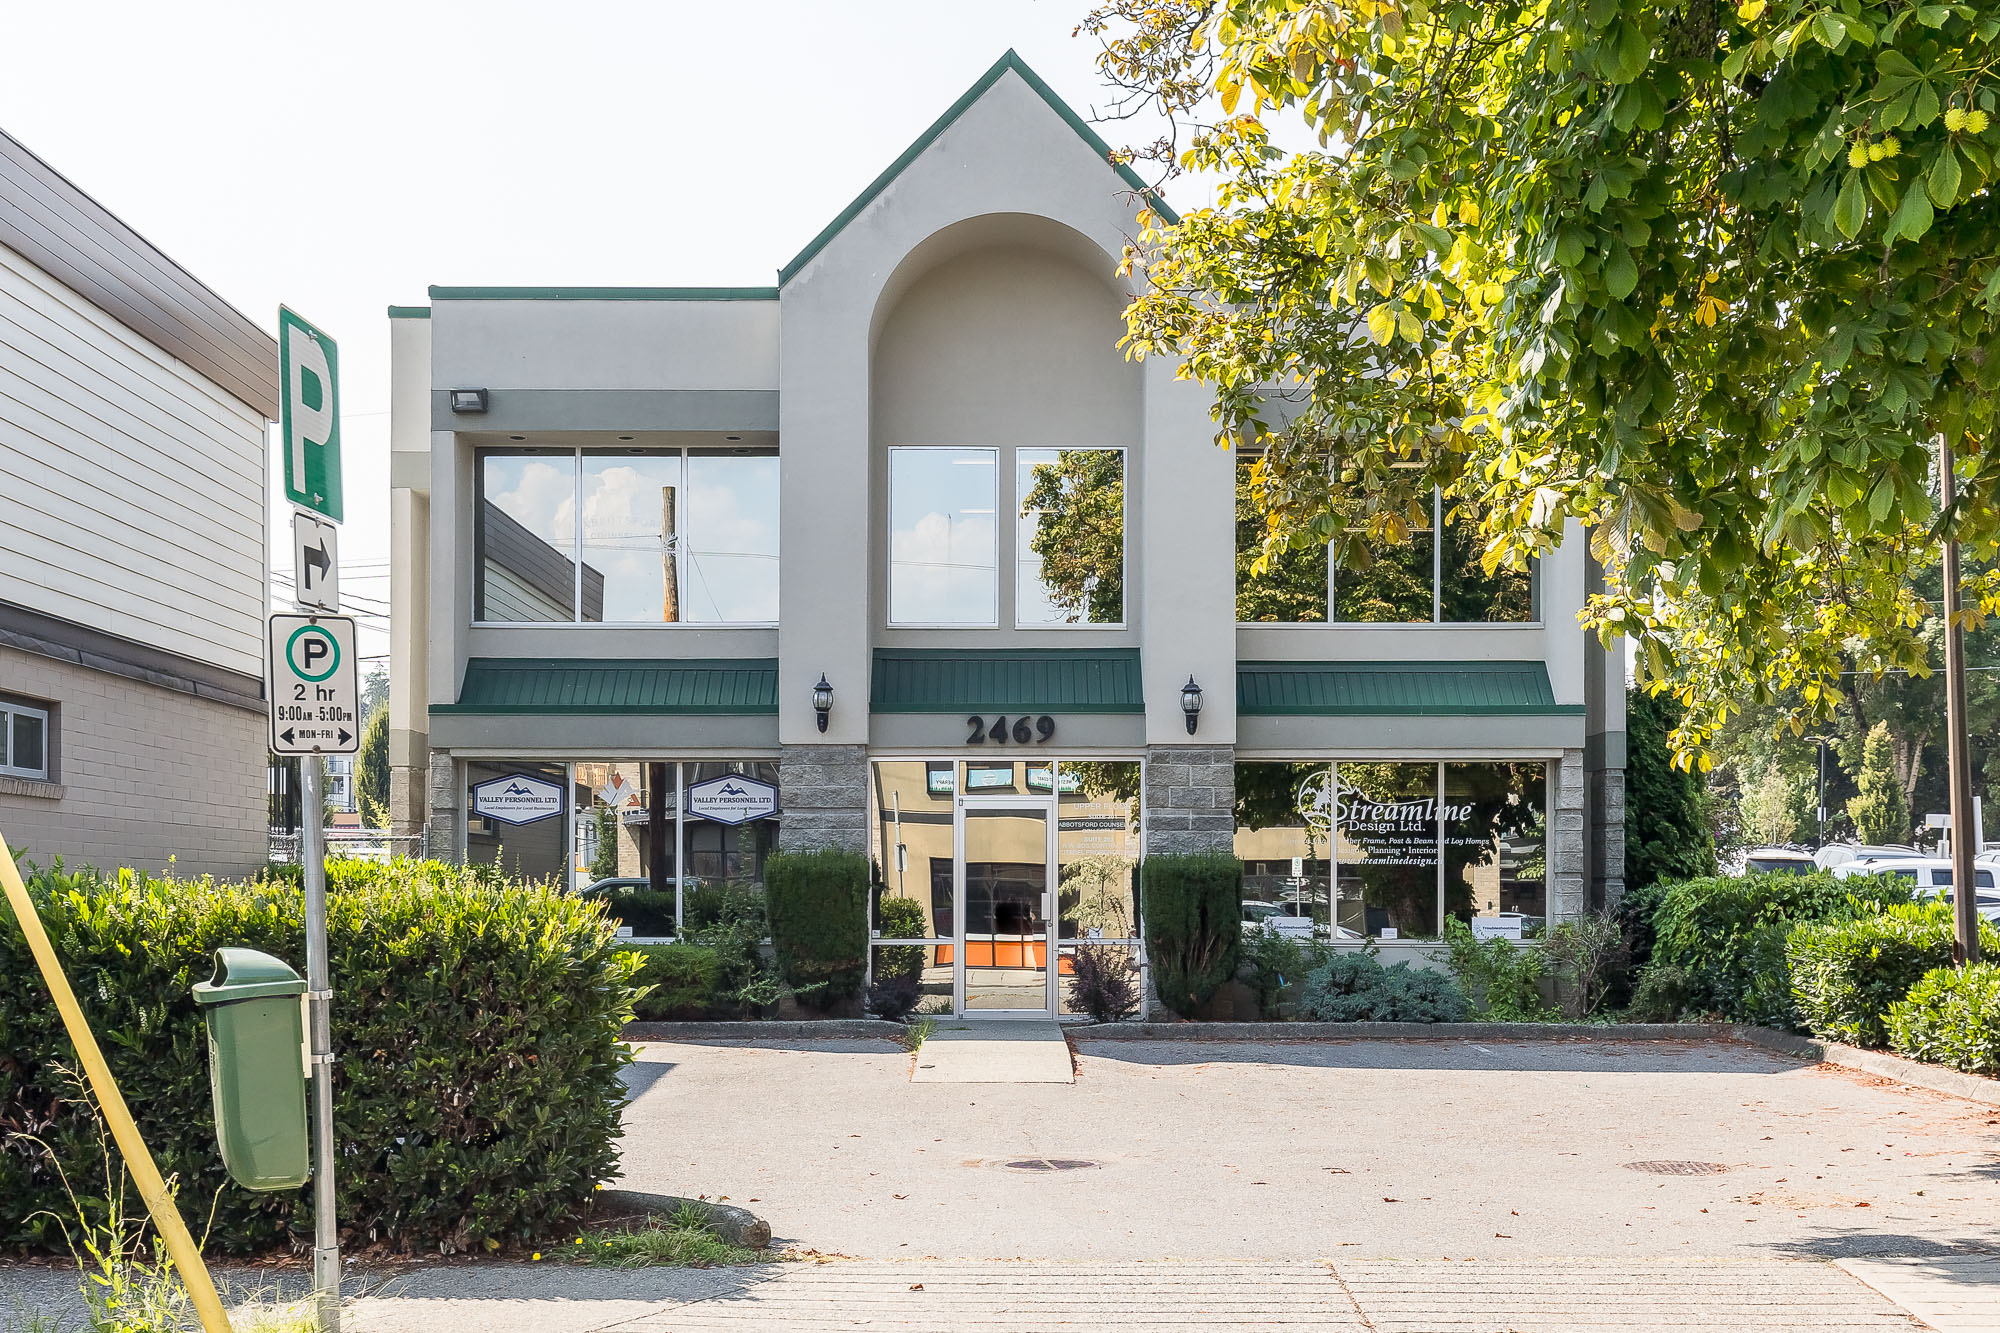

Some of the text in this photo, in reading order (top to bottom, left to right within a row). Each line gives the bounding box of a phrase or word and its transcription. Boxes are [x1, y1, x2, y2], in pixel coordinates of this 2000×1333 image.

[288, 322, 334, 495] P
[304, 638, 328, 669] P
[294, 683, 336, 702] 2 hr
[298, 729, 334, 739] MON-FRI
[966, 715, 1056, 745] 2469
[1348, 820, 1426, 834] Design Ltd.
[1362, 837, 1387, 845] Frame,
[1450, 837, 1464, 846] Log
[1367, 846, 1401, 856] Planning
